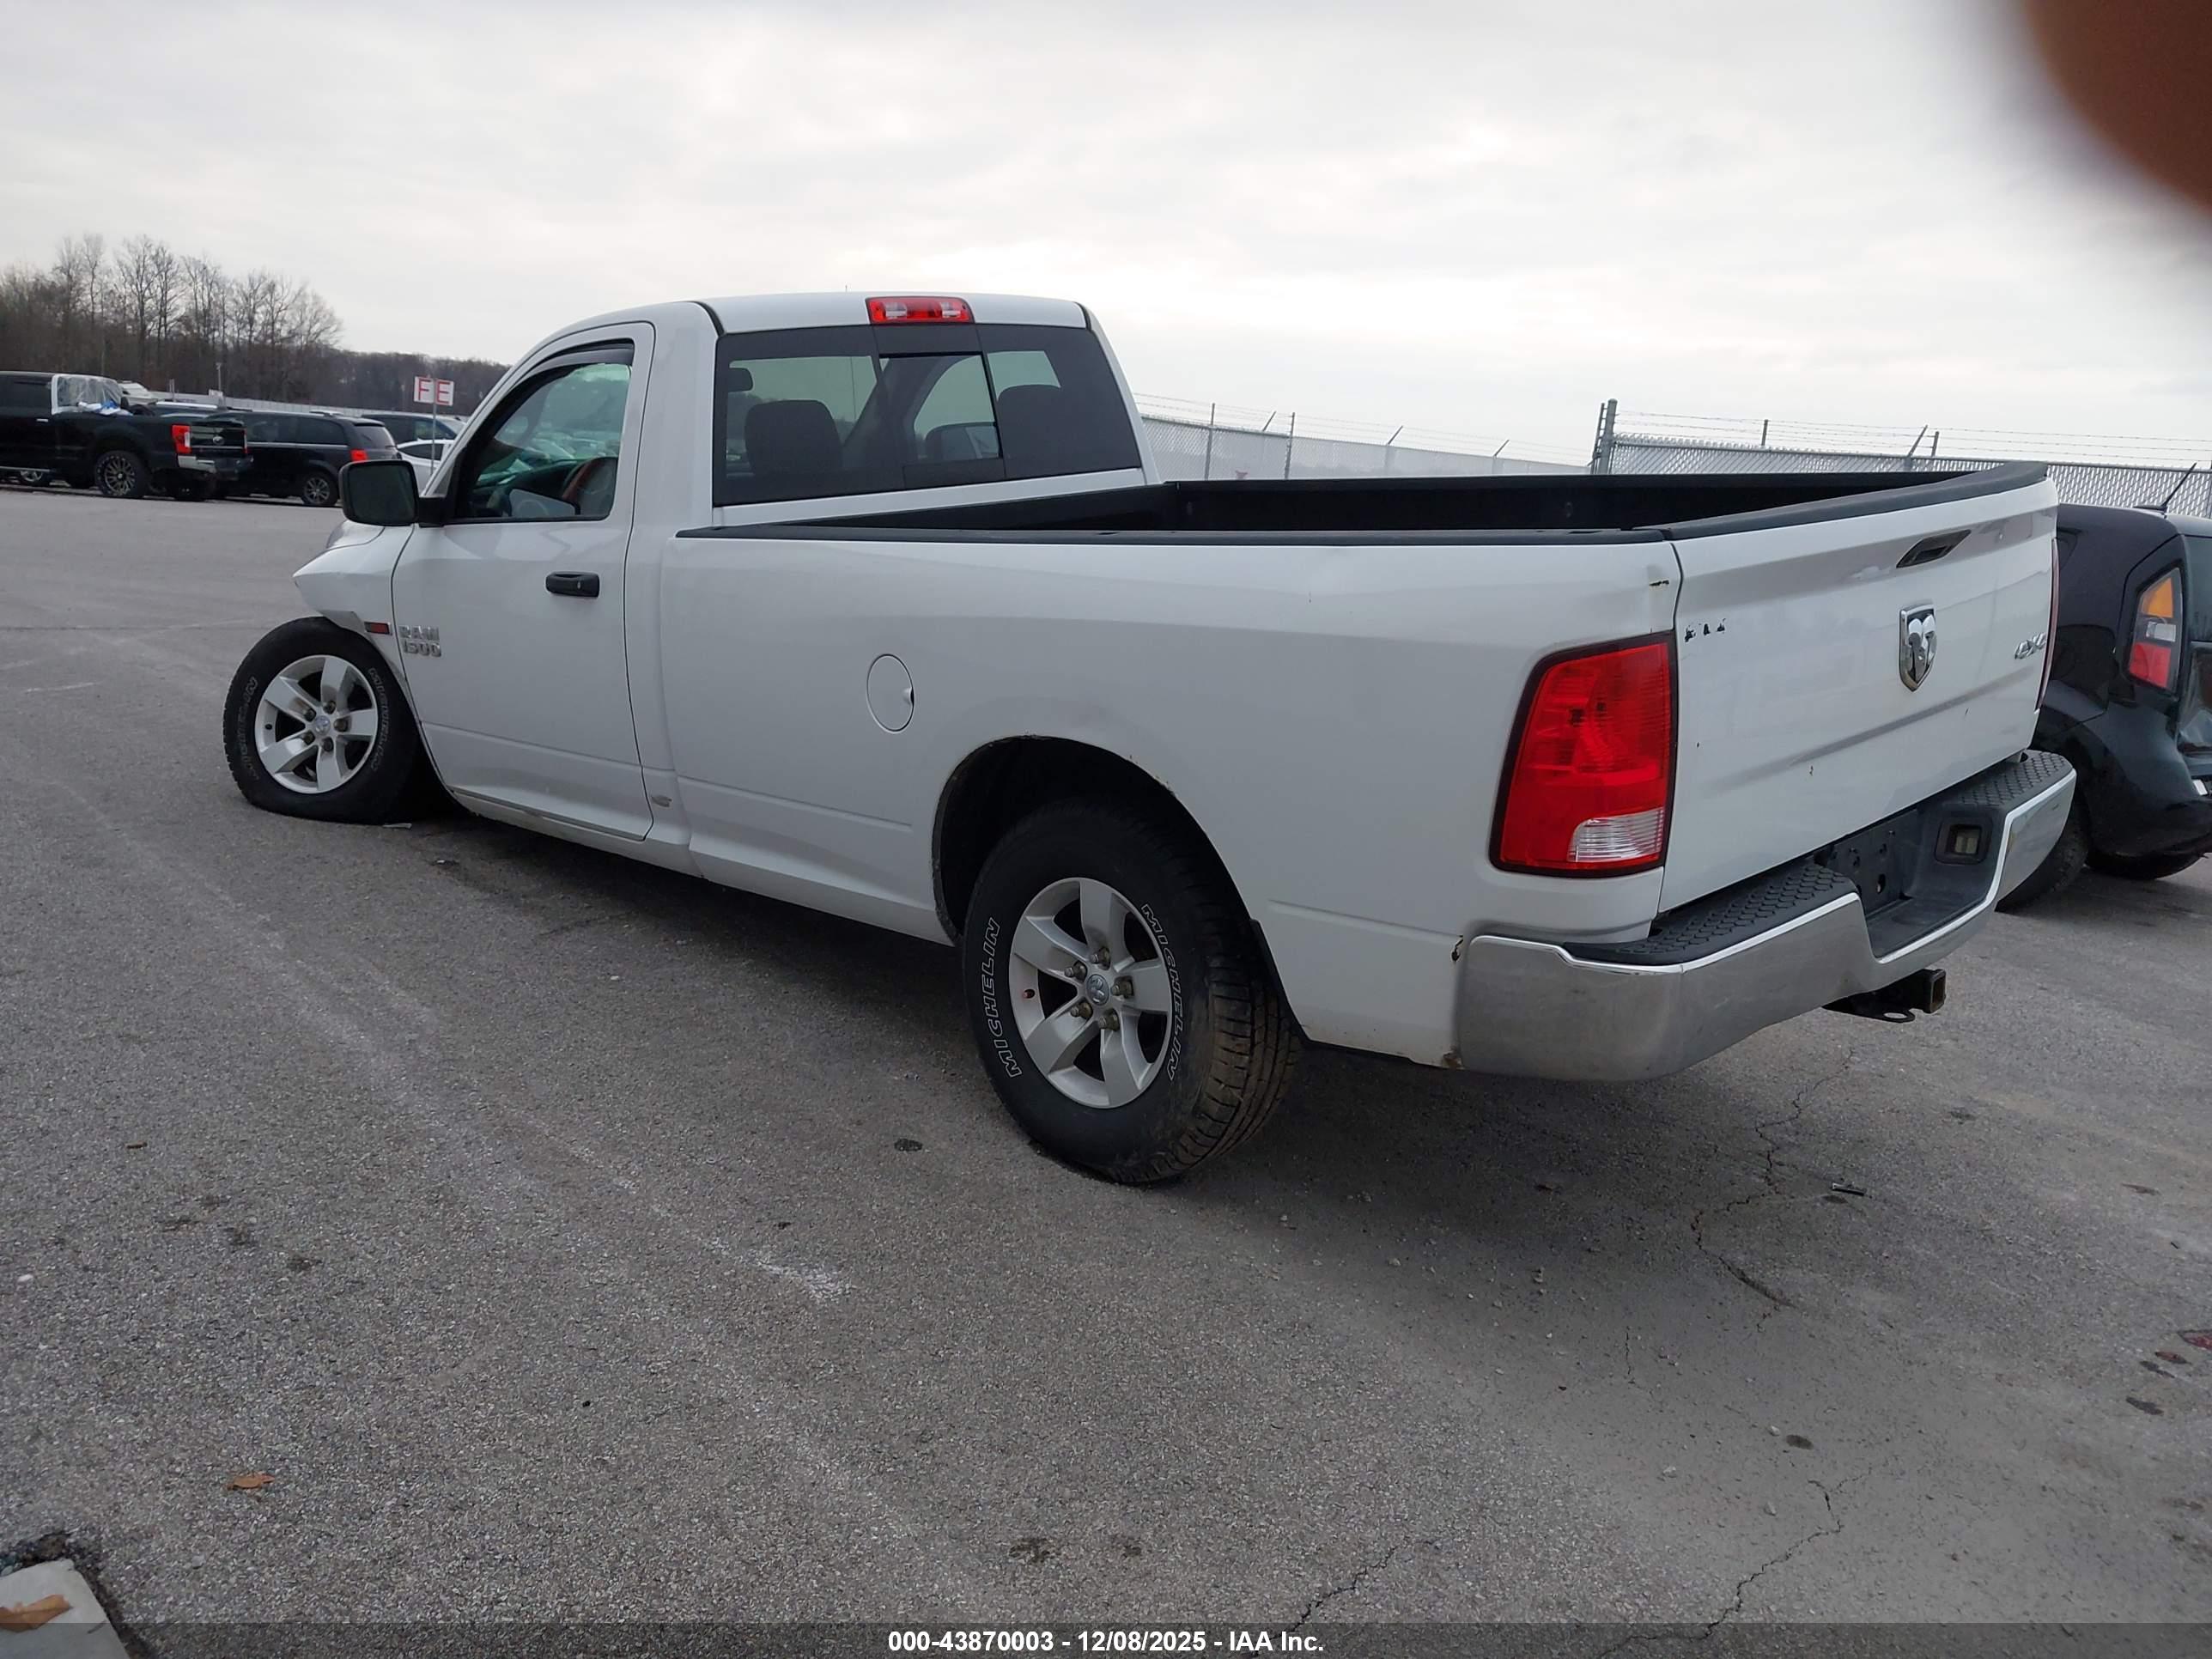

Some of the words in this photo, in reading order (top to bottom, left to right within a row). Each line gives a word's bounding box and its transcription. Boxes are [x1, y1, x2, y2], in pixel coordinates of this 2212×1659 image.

[398, 624, 440, 641] RAM
[403, 639, 441, 657] 1500
[980, 916, 1023, 1079] MICHELIN
[1141, 903, 1184, 1081] MICHELIN
